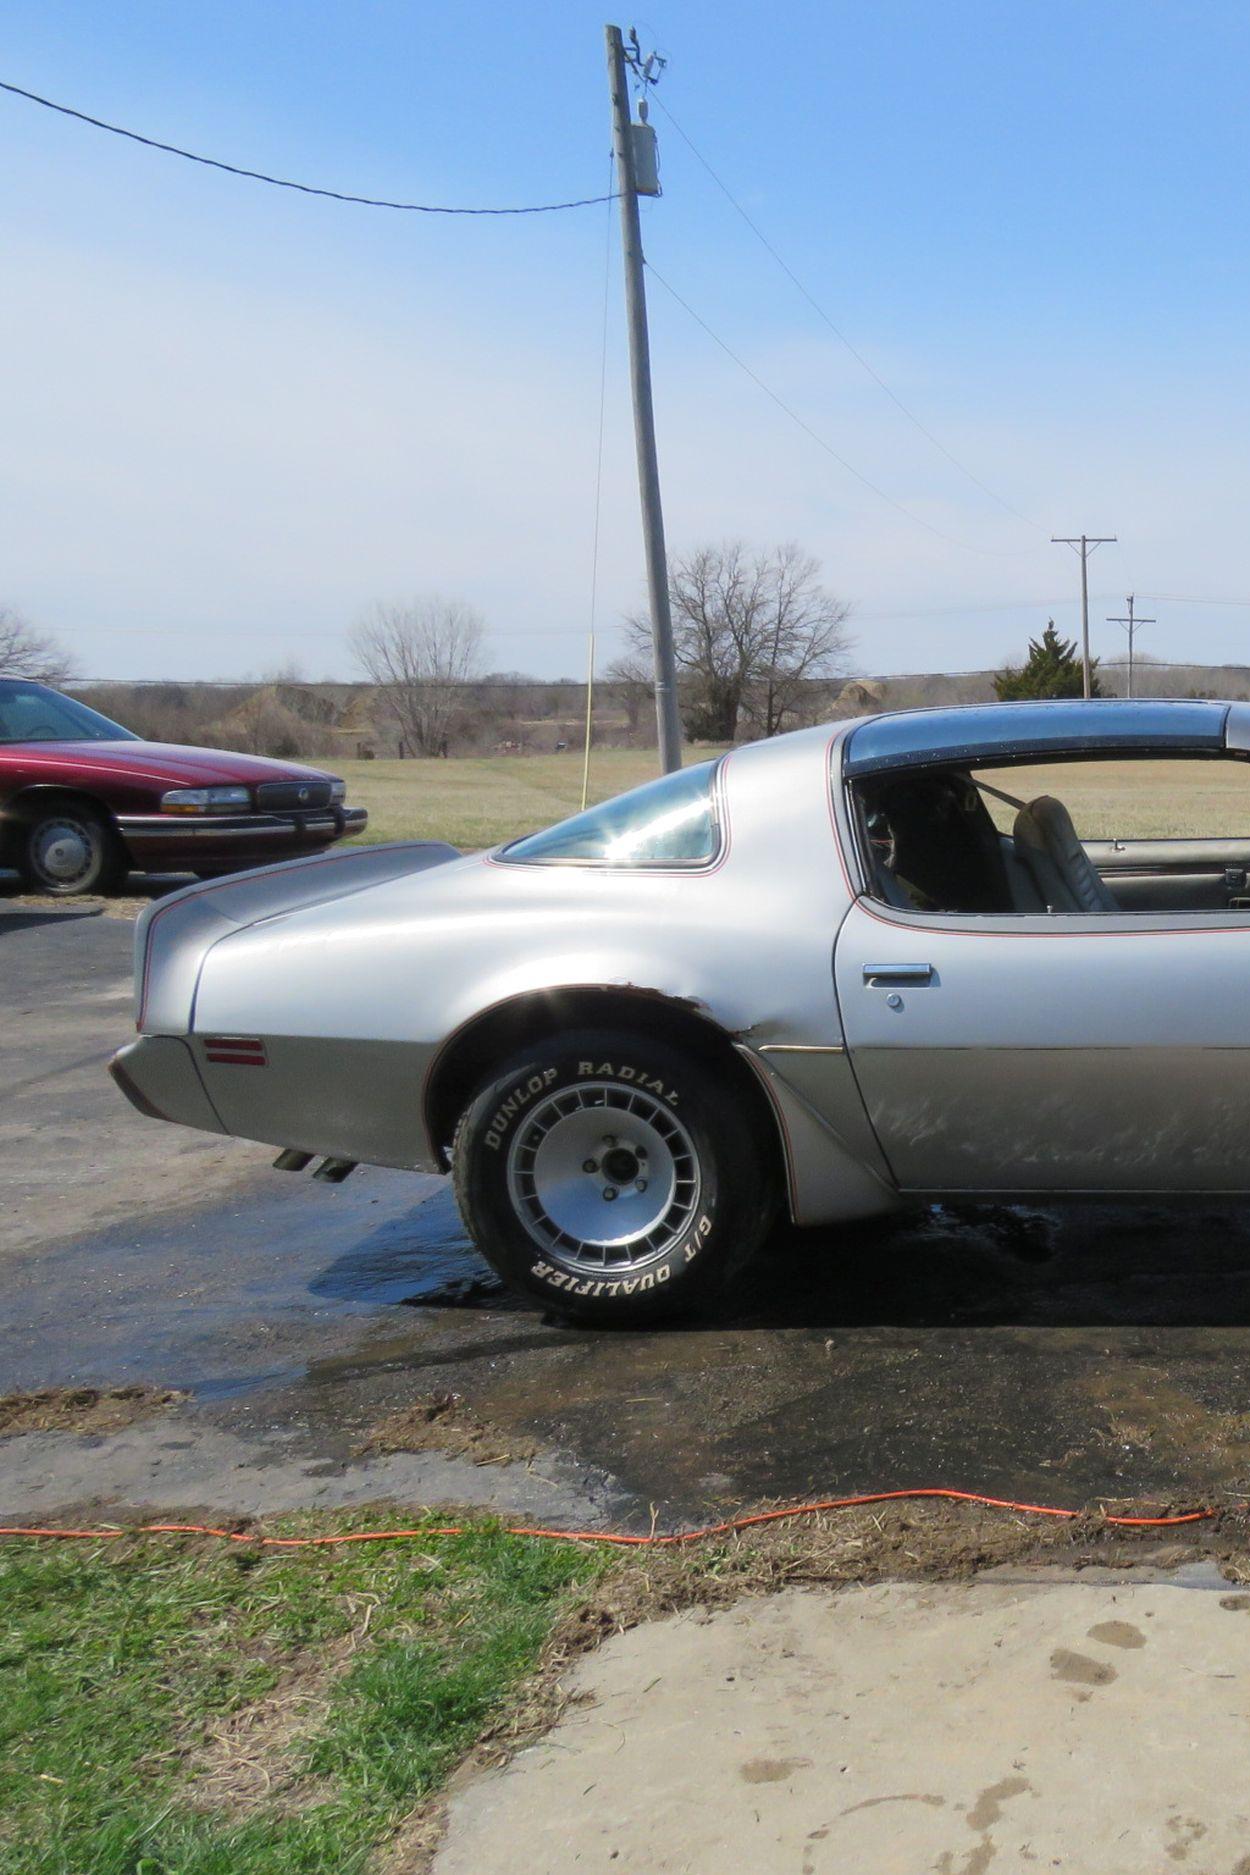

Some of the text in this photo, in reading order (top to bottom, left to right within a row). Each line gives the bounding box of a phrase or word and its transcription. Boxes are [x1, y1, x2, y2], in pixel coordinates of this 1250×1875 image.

[484, 1061, 680, 1150] DUNLOP RADIAL
[531, 1261, 671, 1297] QUALIFIER
